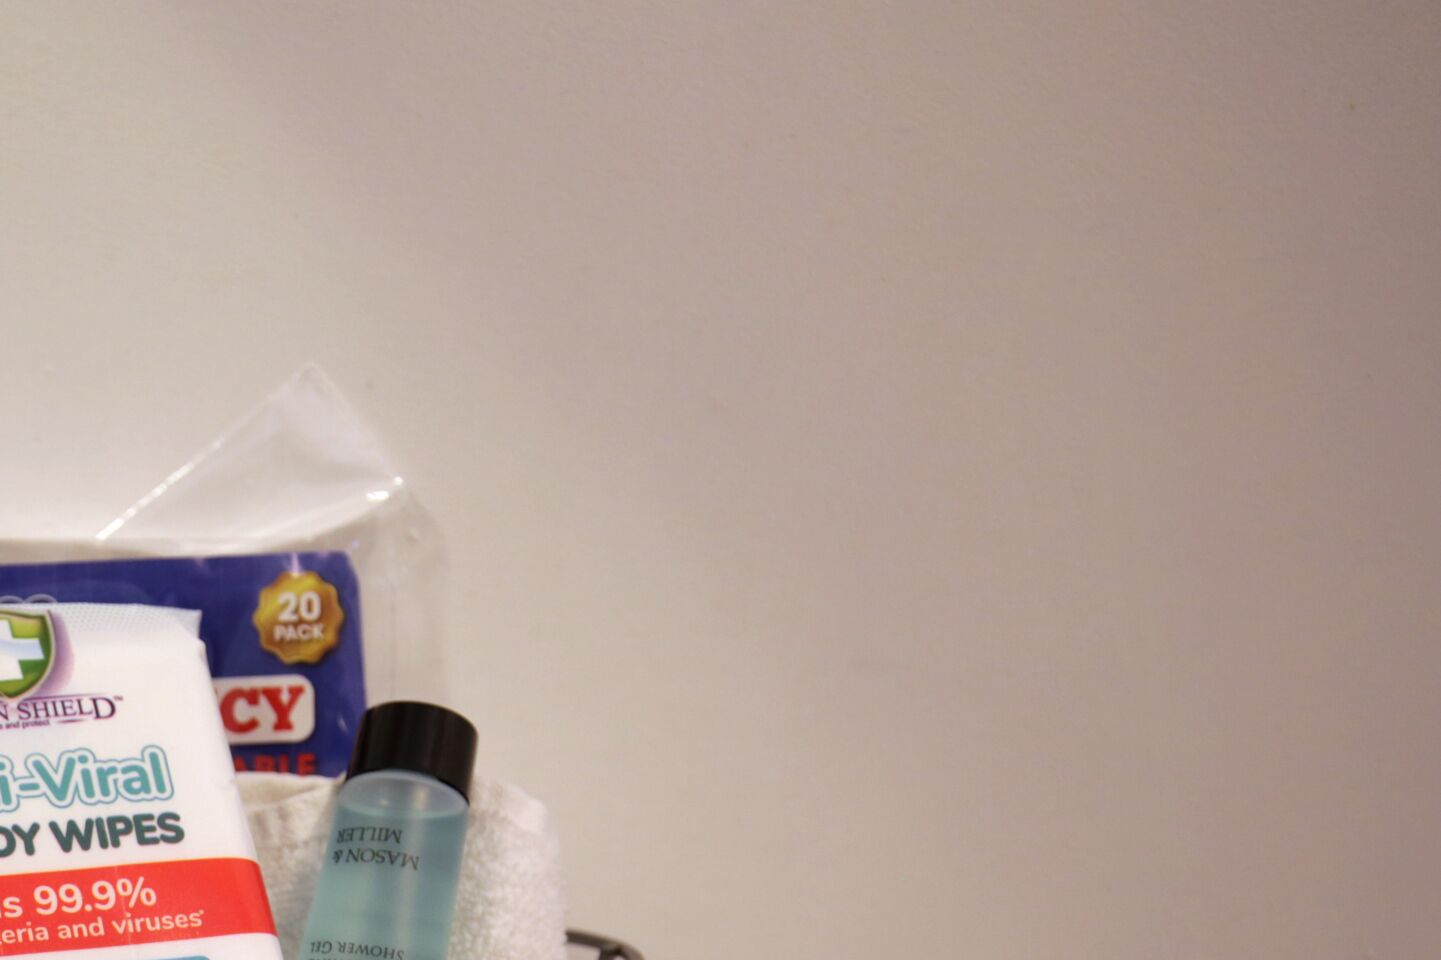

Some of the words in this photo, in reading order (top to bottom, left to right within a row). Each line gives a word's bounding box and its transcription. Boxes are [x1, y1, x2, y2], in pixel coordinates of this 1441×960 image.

[278, 591, 322, 622] 20
[274, 623, 325, 641] PACK
[220, 685, 306, 734] CY
[5, 721, 21, 730] and
[21, 718, 51, 730] protect
[48, 811, 185, 853] WIPES
[336, 826, 403, 844] MILLER
[345, 848, 420, 871] MASON
[32, 876, 158, 916] 99.9%
[57, 916, 106, 940] and
